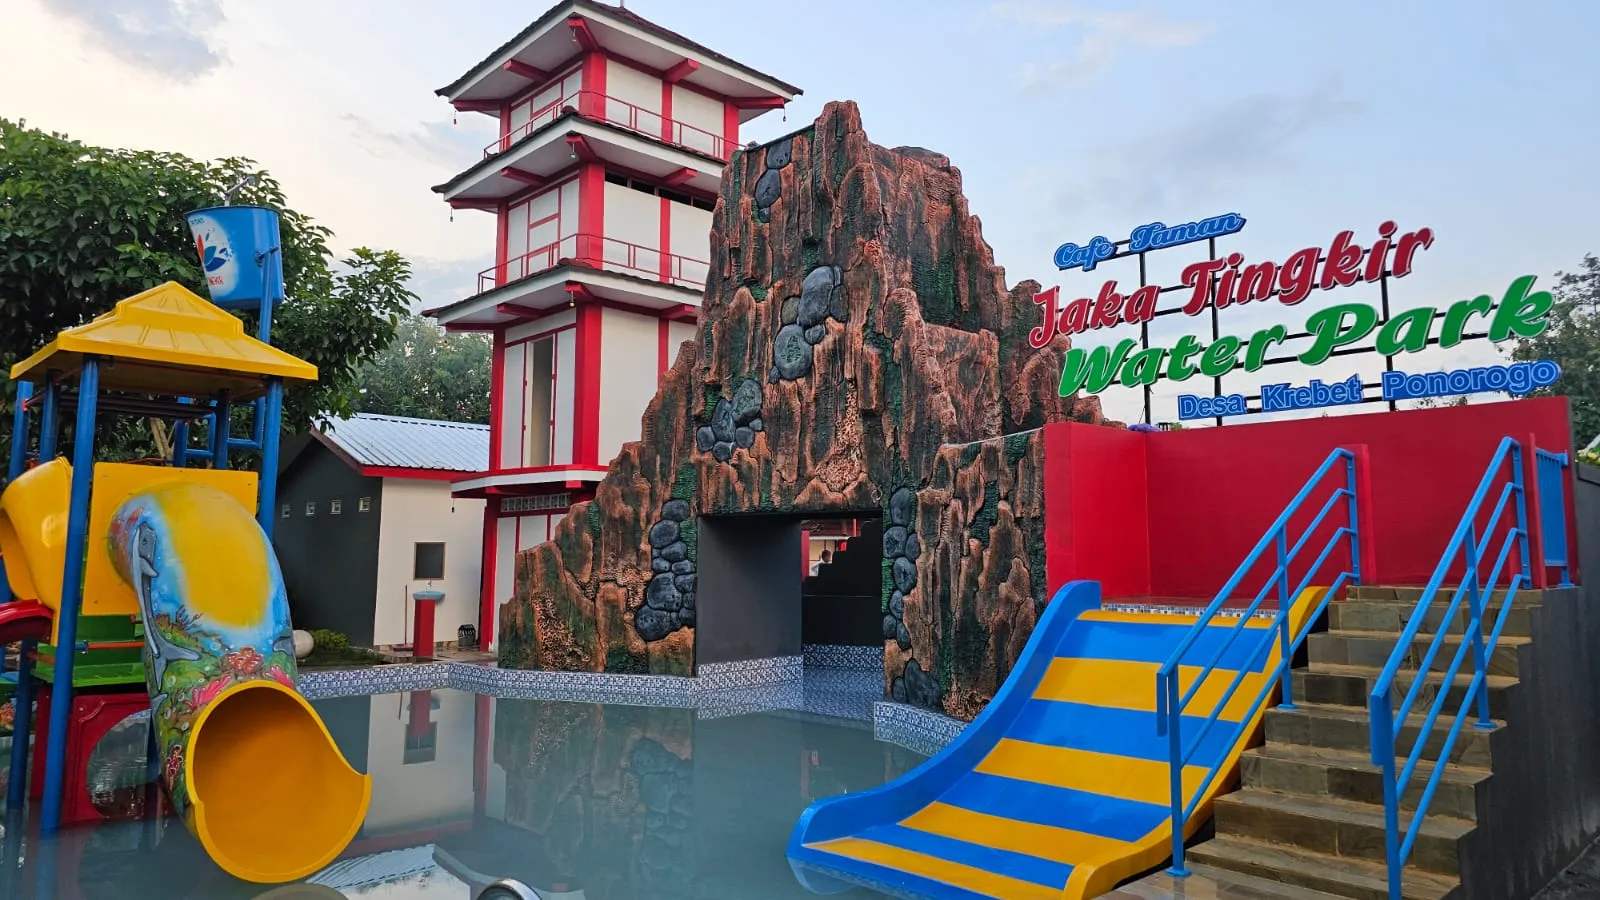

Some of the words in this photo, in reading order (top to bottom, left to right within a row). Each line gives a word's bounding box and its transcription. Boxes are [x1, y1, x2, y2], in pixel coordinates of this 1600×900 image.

[1029, 281, 1161, 347] Jaka
[1181, 221, 1434, 315] Tingkir
[1054, 236, 1115, 271] Cafe
[1130, 213, 1244, 251] Taman
[1058, 324, 1288, 397] Water
[1298, 275, 1556, 365] Park
[1181, 396, 1242, 417] Desa
[1264, 375, 1360, 408] Krebet
[1384, 360, 1559, 398] Ponorogo
